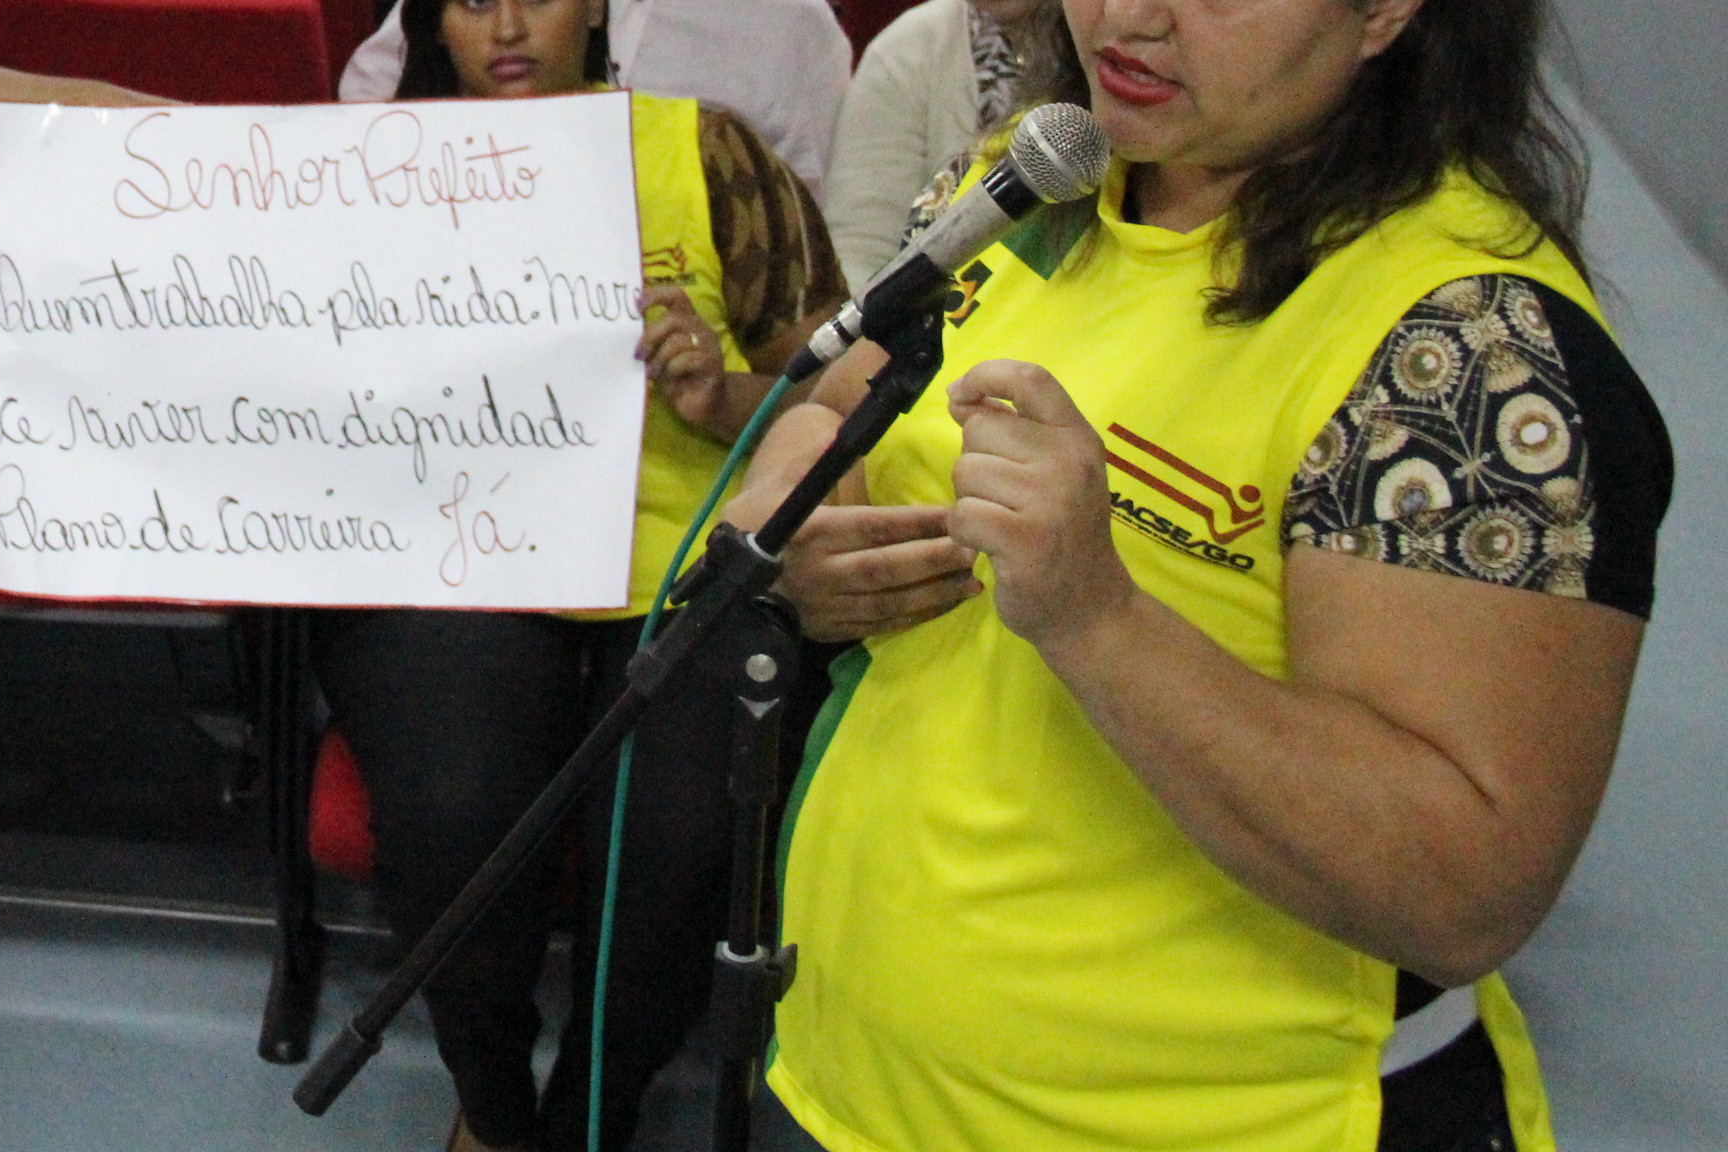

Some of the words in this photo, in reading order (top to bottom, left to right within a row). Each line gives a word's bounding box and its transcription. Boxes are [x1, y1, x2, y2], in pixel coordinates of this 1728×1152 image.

[114, 111, 355, 219] Senhor
[344, 110, 542, 230] Prefeito
[80, 254, 314, 331] trabalha
[319, 260, 409, 347] pela
[58, 393, 218, 451] viver
[338, 374, 598, 484] dignidade
[128, 488, 210, 553] de
[215, 488, 411, 554] Carreira
[438, 471, 537, 587] Já.
